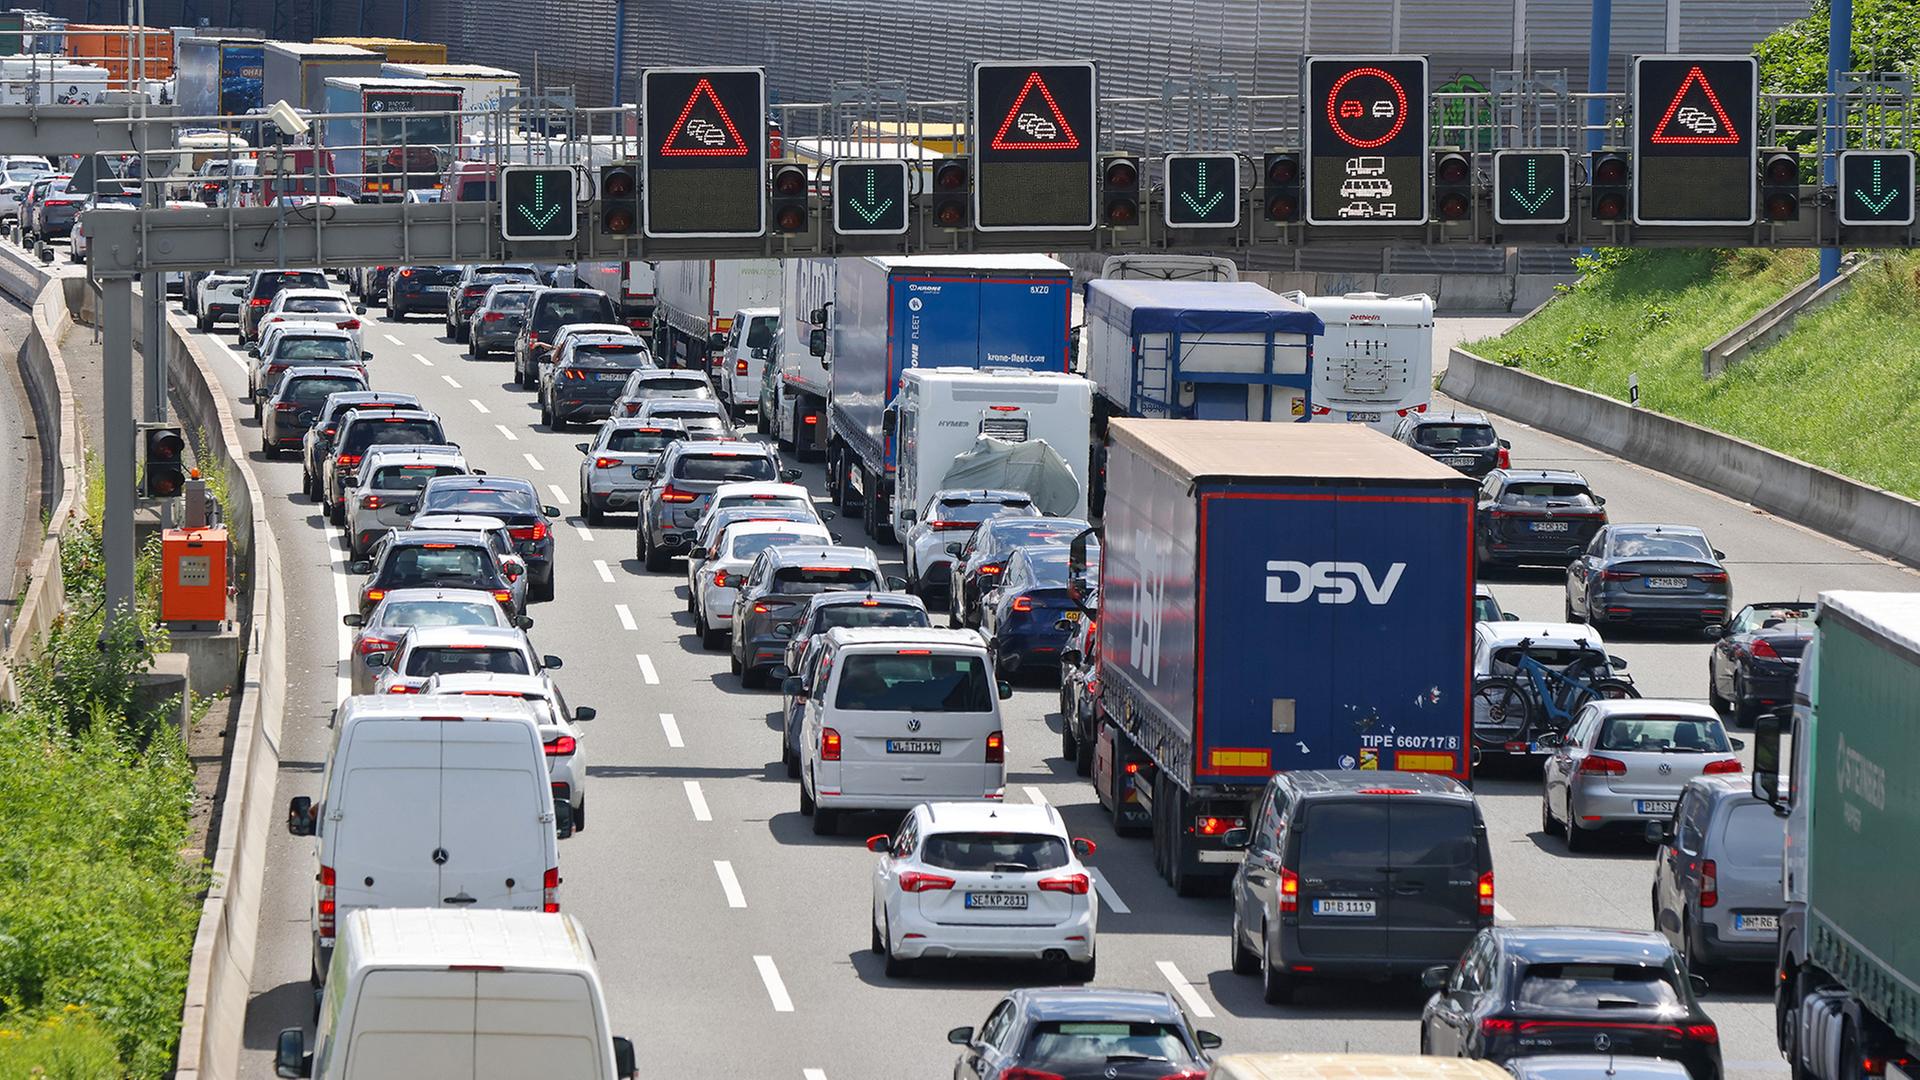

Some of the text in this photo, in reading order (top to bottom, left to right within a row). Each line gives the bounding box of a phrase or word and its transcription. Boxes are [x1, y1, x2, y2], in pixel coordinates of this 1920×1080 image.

[911, 314, 920, 369] ONE FLEET
[1266, 560, 1407, 605] DSV
[1362, 735, 1393, 747] TIPE
[923, 743, 939, 752] 117
[1645, 801, 1655, 811] PI
[973, 895, 1027, 906] SE KP 2811
[1346, 902, 1371, 912] 1119
